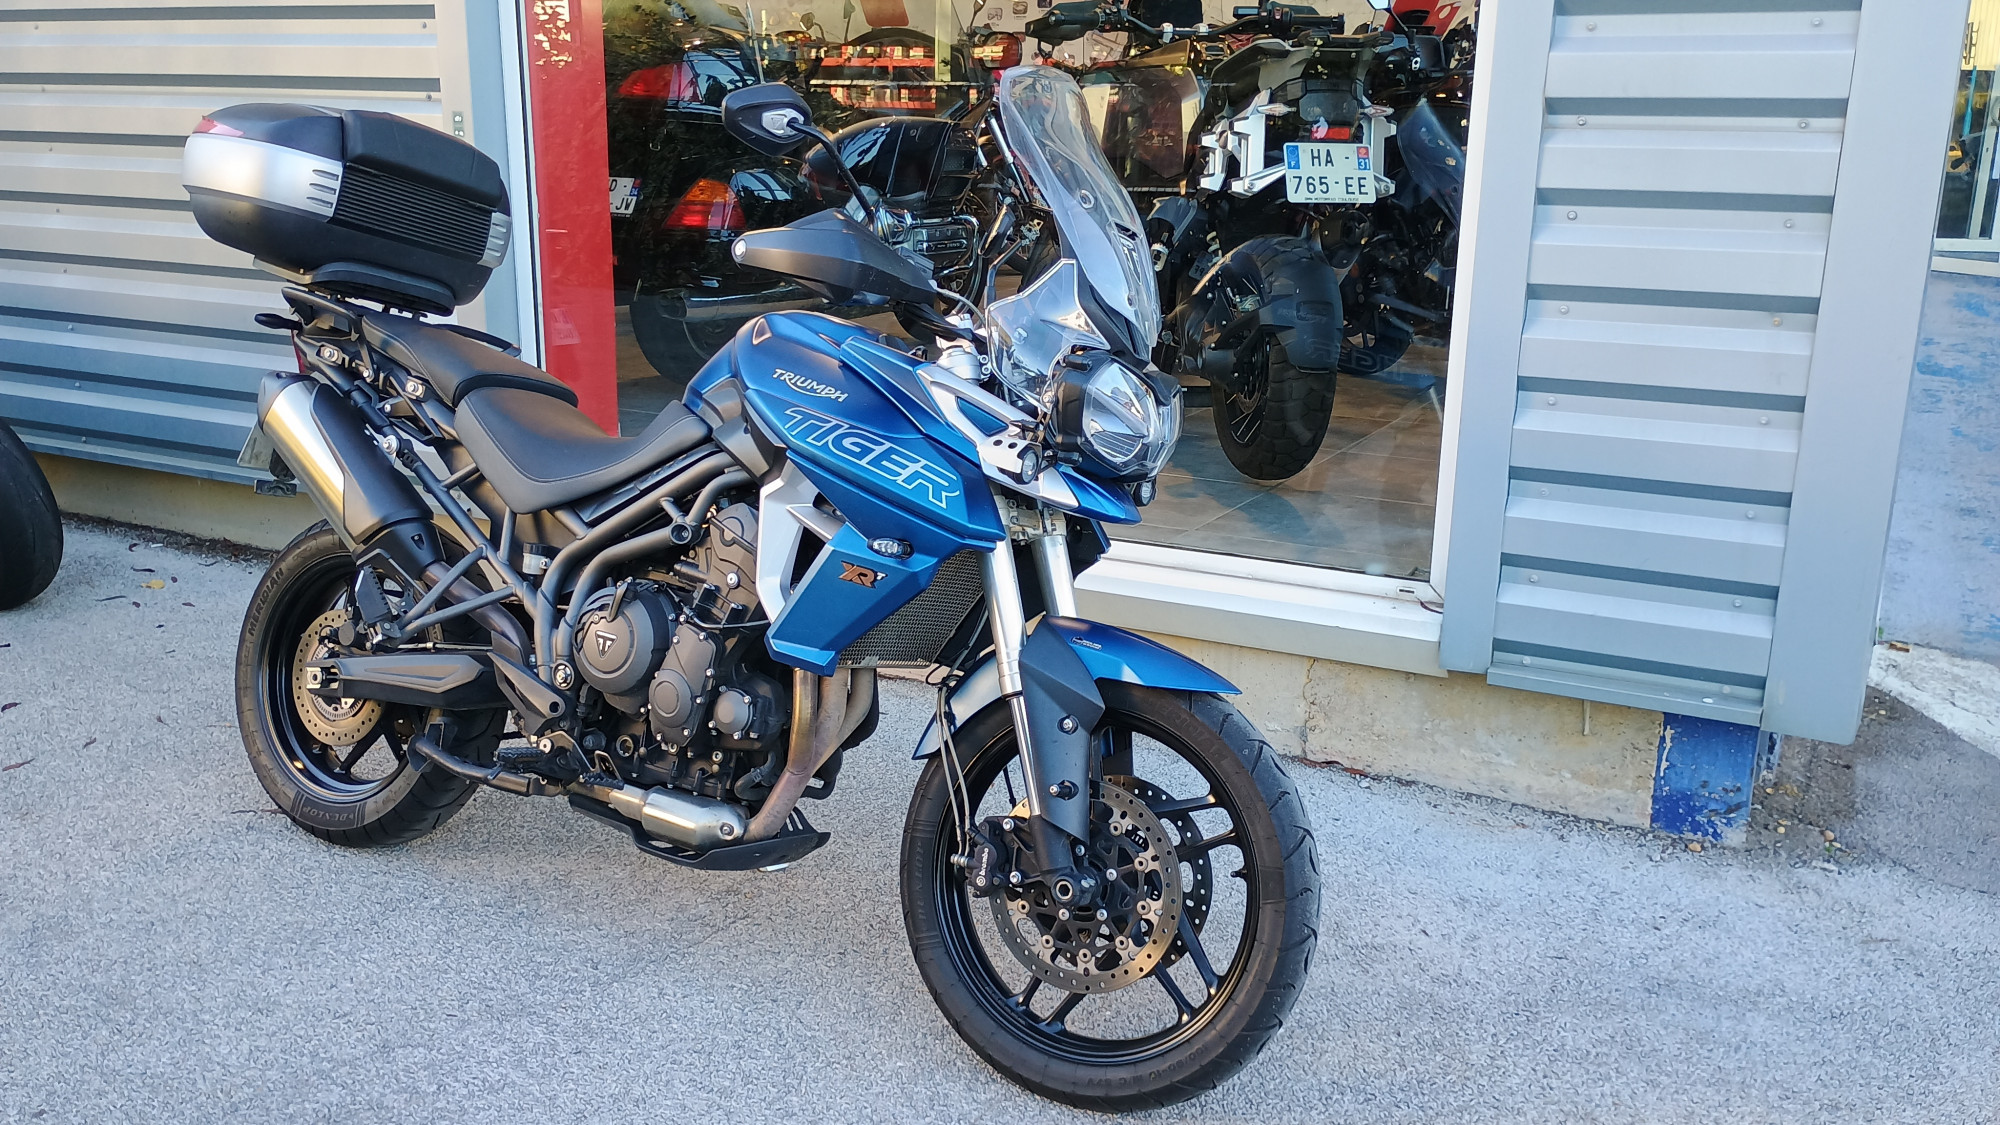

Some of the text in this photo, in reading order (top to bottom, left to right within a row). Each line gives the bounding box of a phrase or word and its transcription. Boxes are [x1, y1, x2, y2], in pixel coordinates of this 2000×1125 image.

[1310, 148, 1335, 167] HA
[1358, 158, 1370, 170] 31
[609, 178, 618, 192] D
[1292, 175, 1369, 196] 765-EE
[772, 368, 849, 403] TRIUMPH
[784, 407, 960, 510] TIGER
[247, 567, 285, 638] MERIDIAN
[302, 805, 349, 820] DUNLOP
[979, 847, 989, 876] brembo
